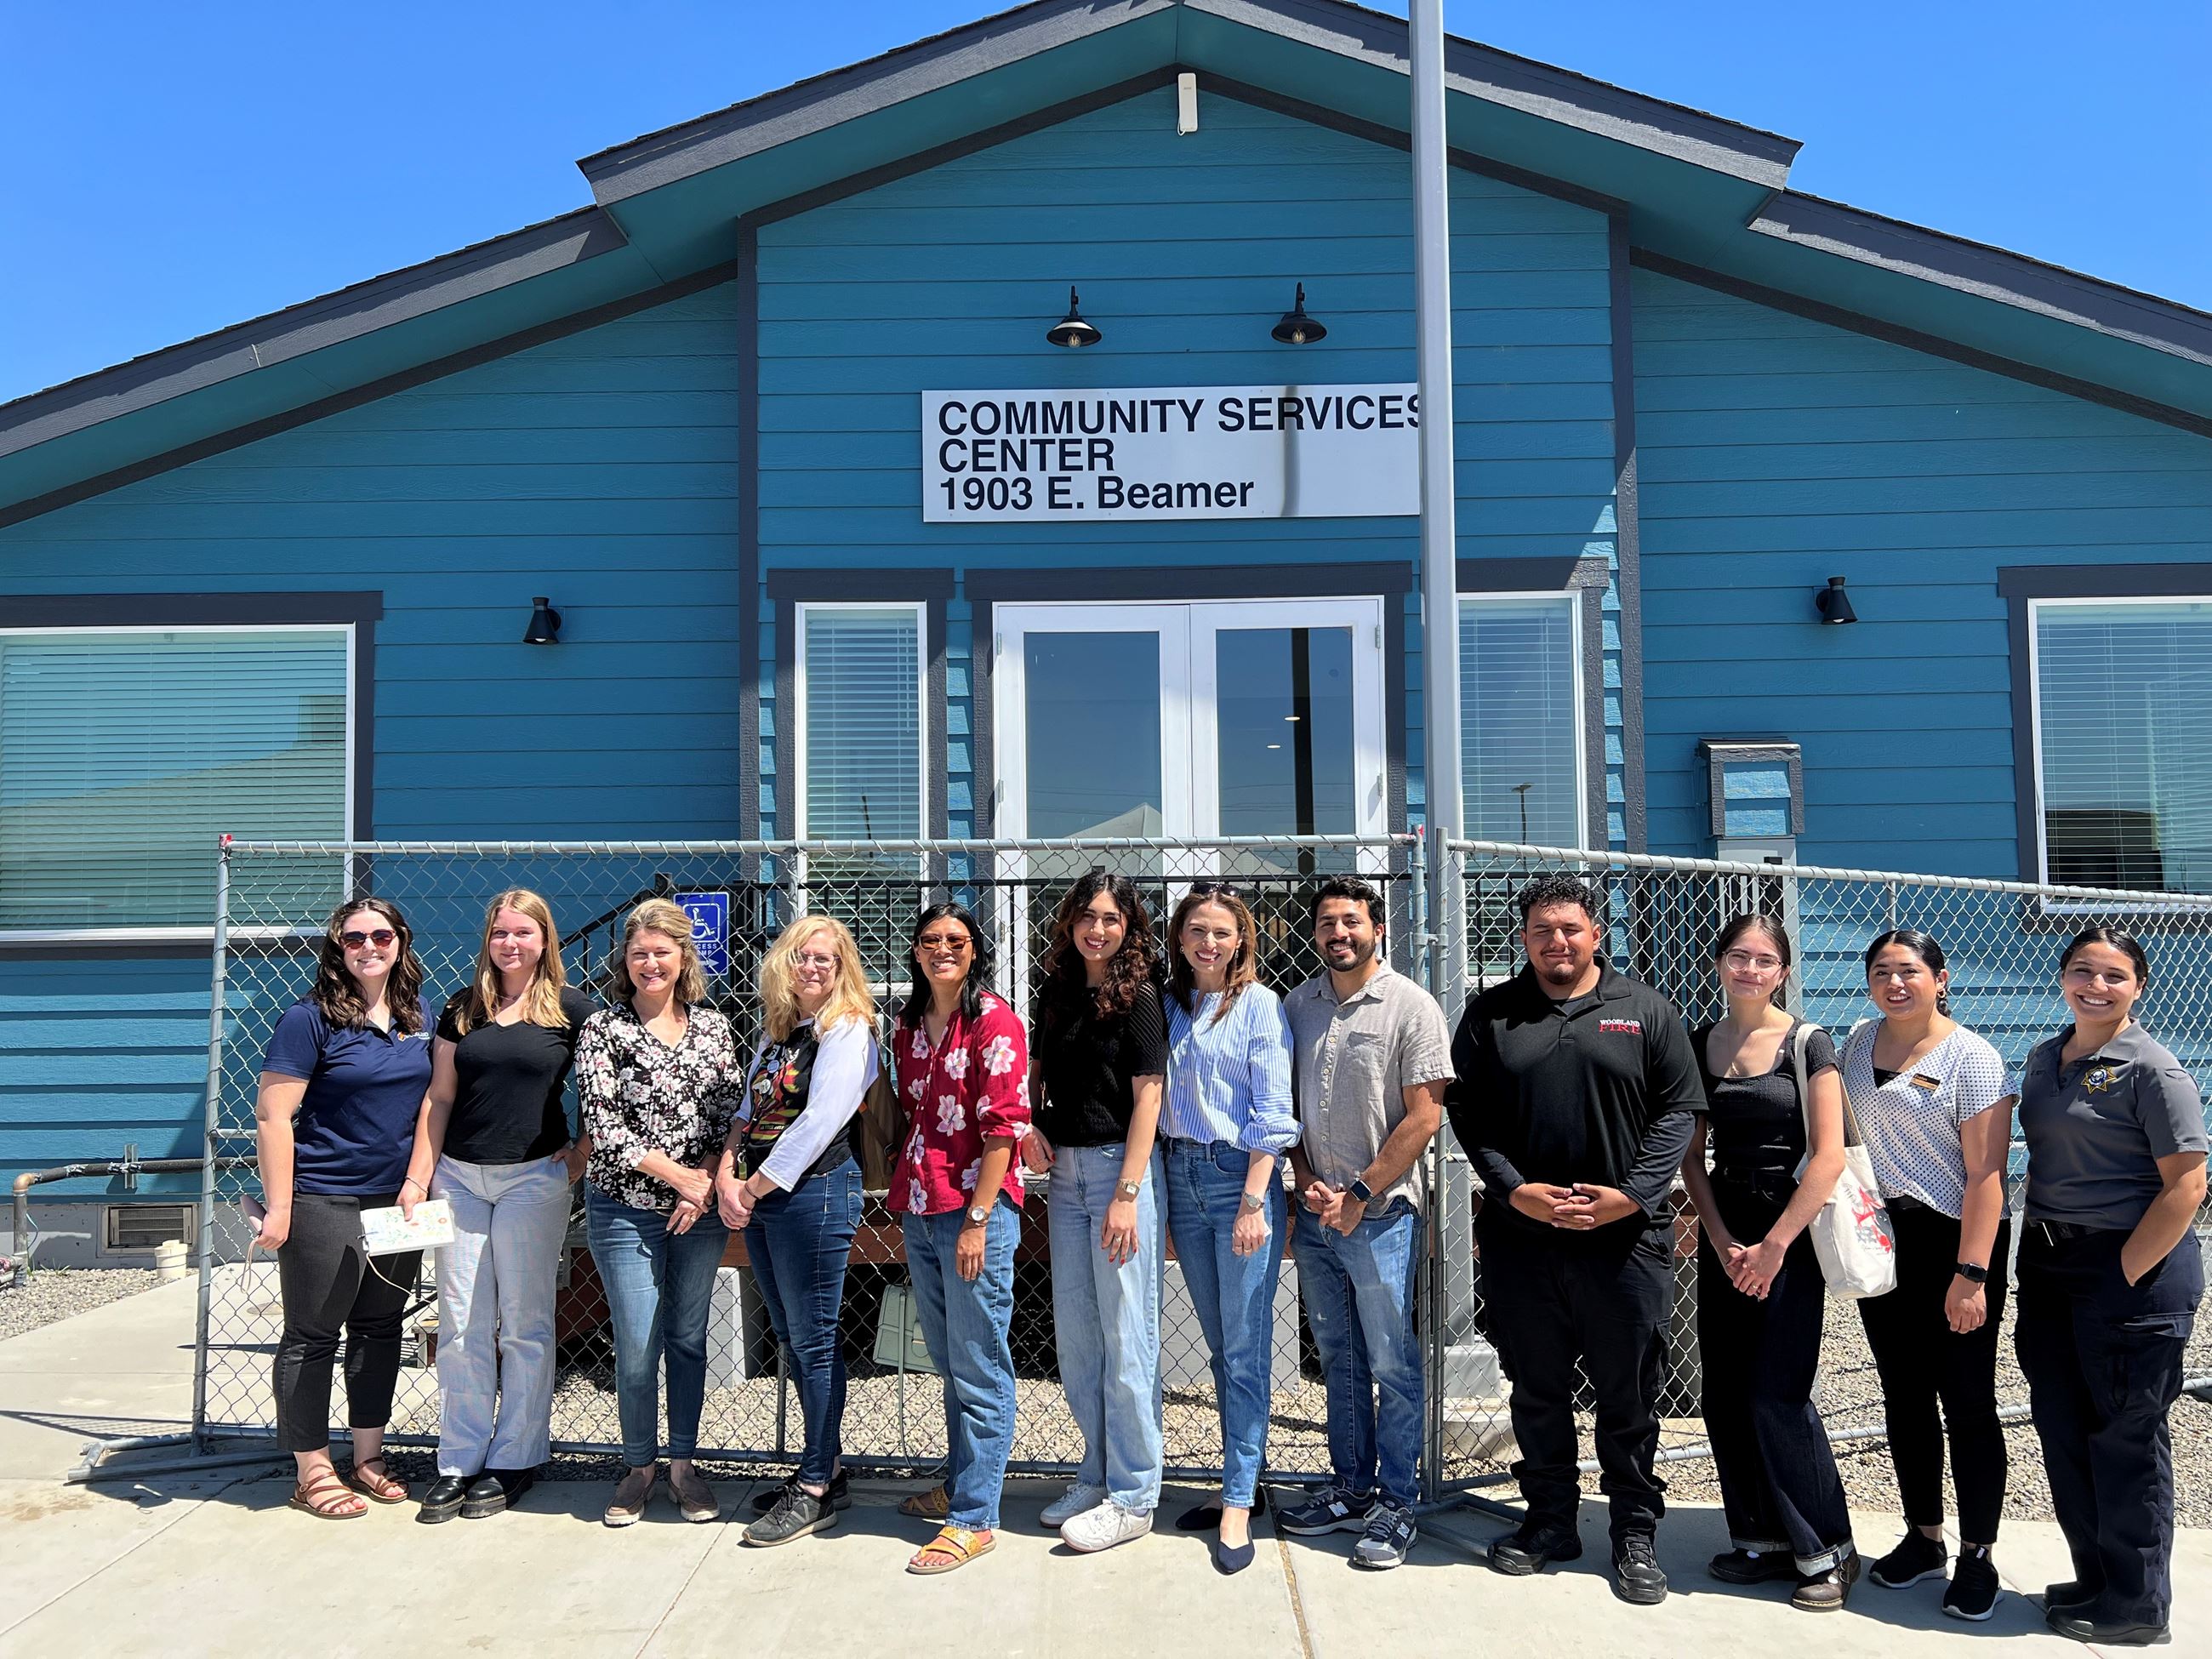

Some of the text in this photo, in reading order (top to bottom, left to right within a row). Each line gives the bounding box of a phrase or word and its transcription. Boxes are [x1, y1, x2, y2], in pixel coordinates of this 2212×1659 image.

[938, 399, 1205, 436] COMMUNITY
[938, 438, 1115, 473] CENTER
[940, 476, 1254, 511] 1903 E. Beamer
[1599, 1023, 1641, 1035] FIRE
